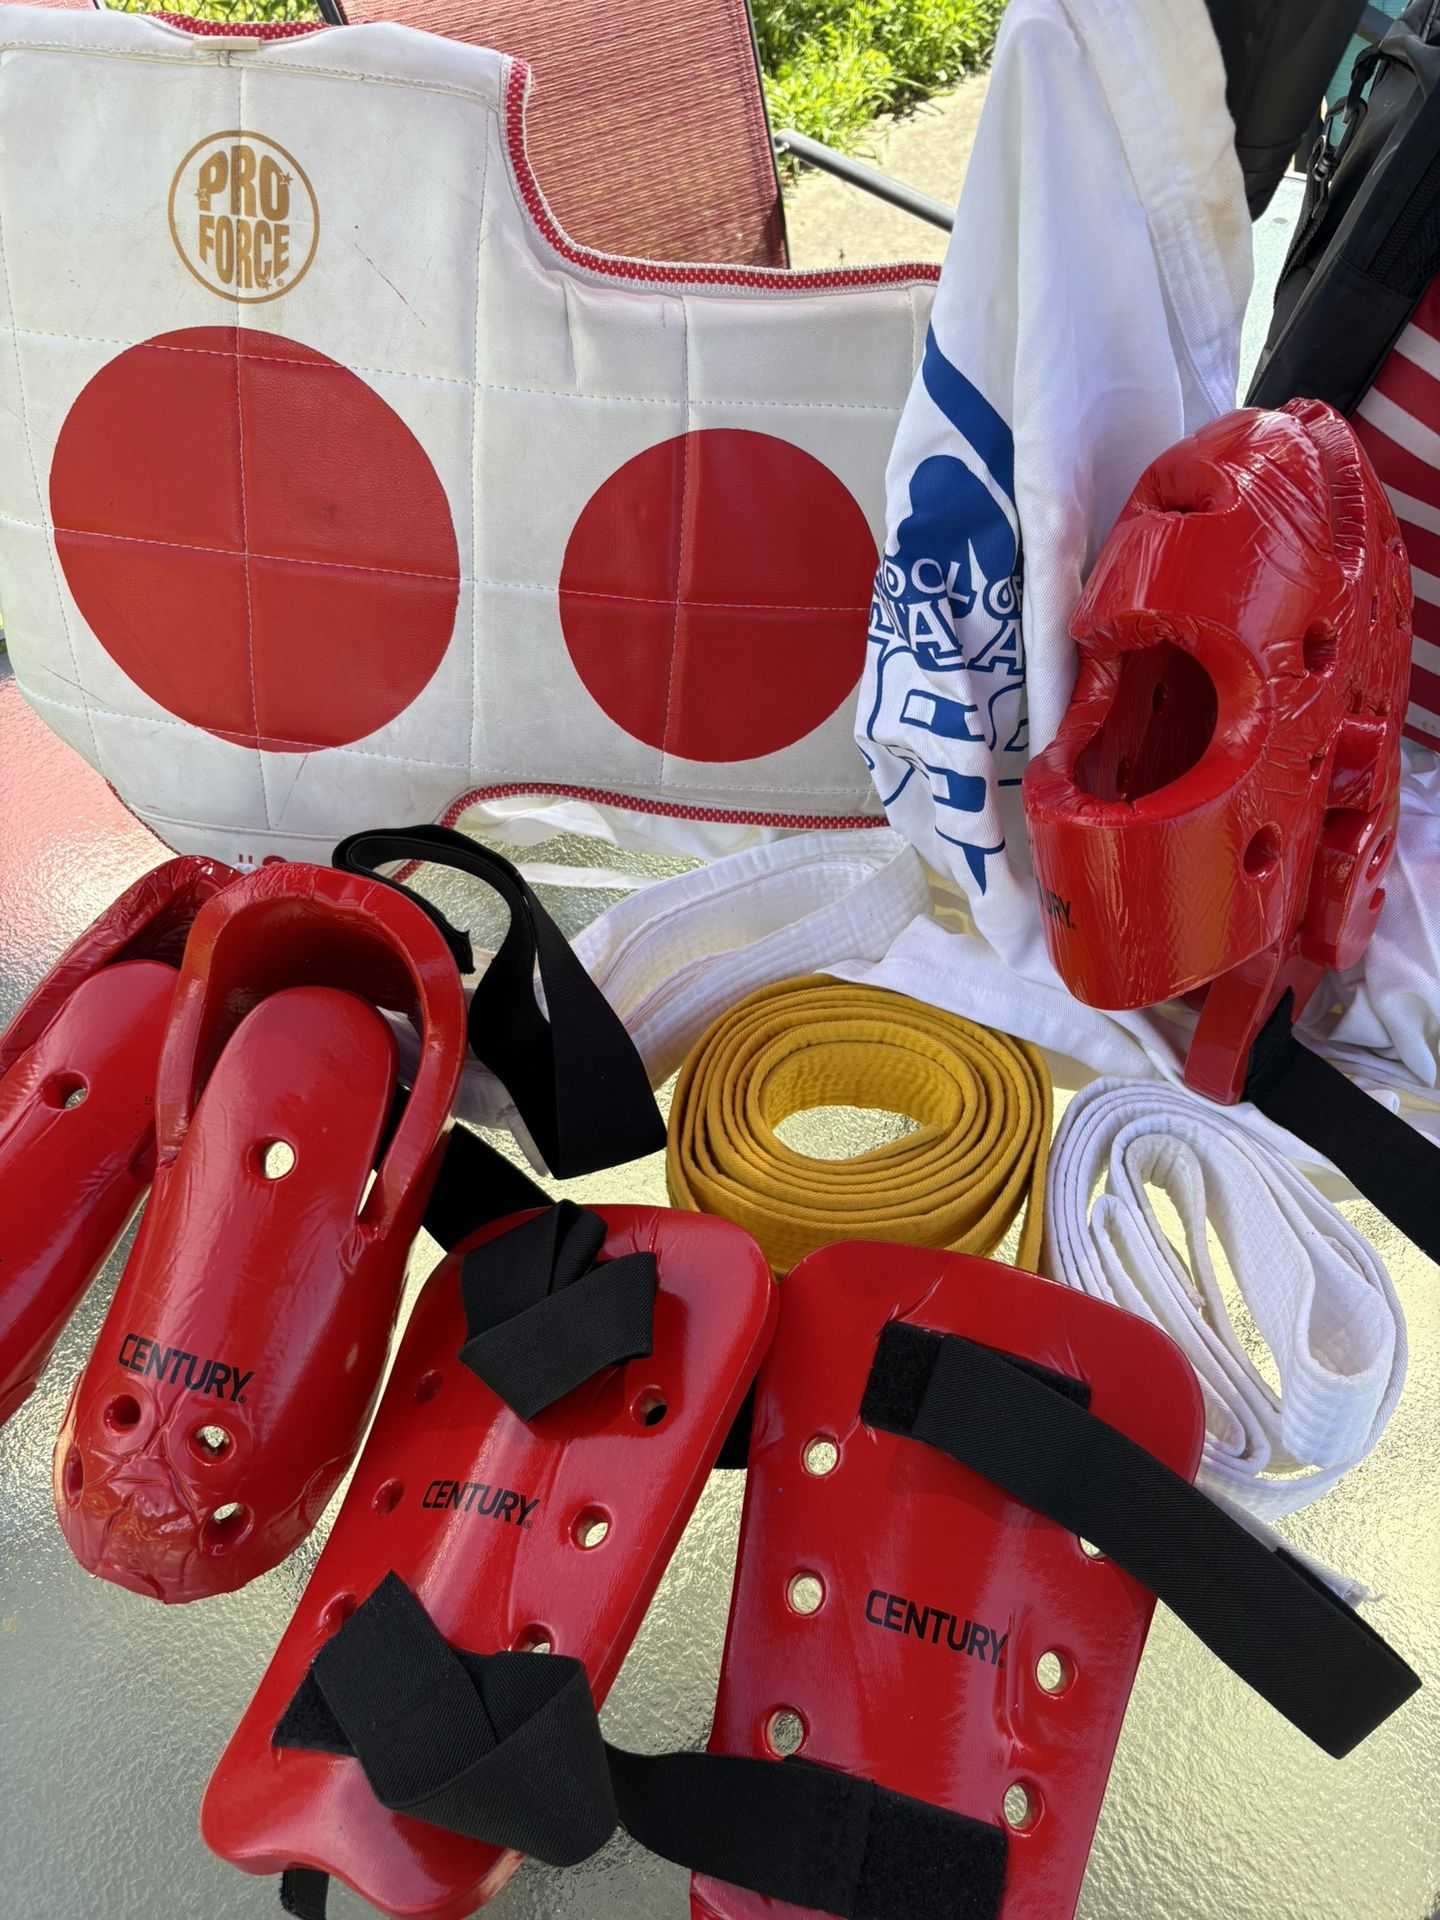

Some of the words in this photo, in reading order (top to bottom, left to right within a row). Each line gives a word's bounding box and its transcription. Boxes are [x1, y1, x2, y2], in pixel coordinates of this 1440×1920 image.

[199, 144, 290, 222] PRO
[199, 214, 290, 289] FORCE
[118, 1333, 255, 1402] CENTURY
[422, 1480, 540, 1526] CENTURY
[865, 1589, 1009, 1665] CENTURY
